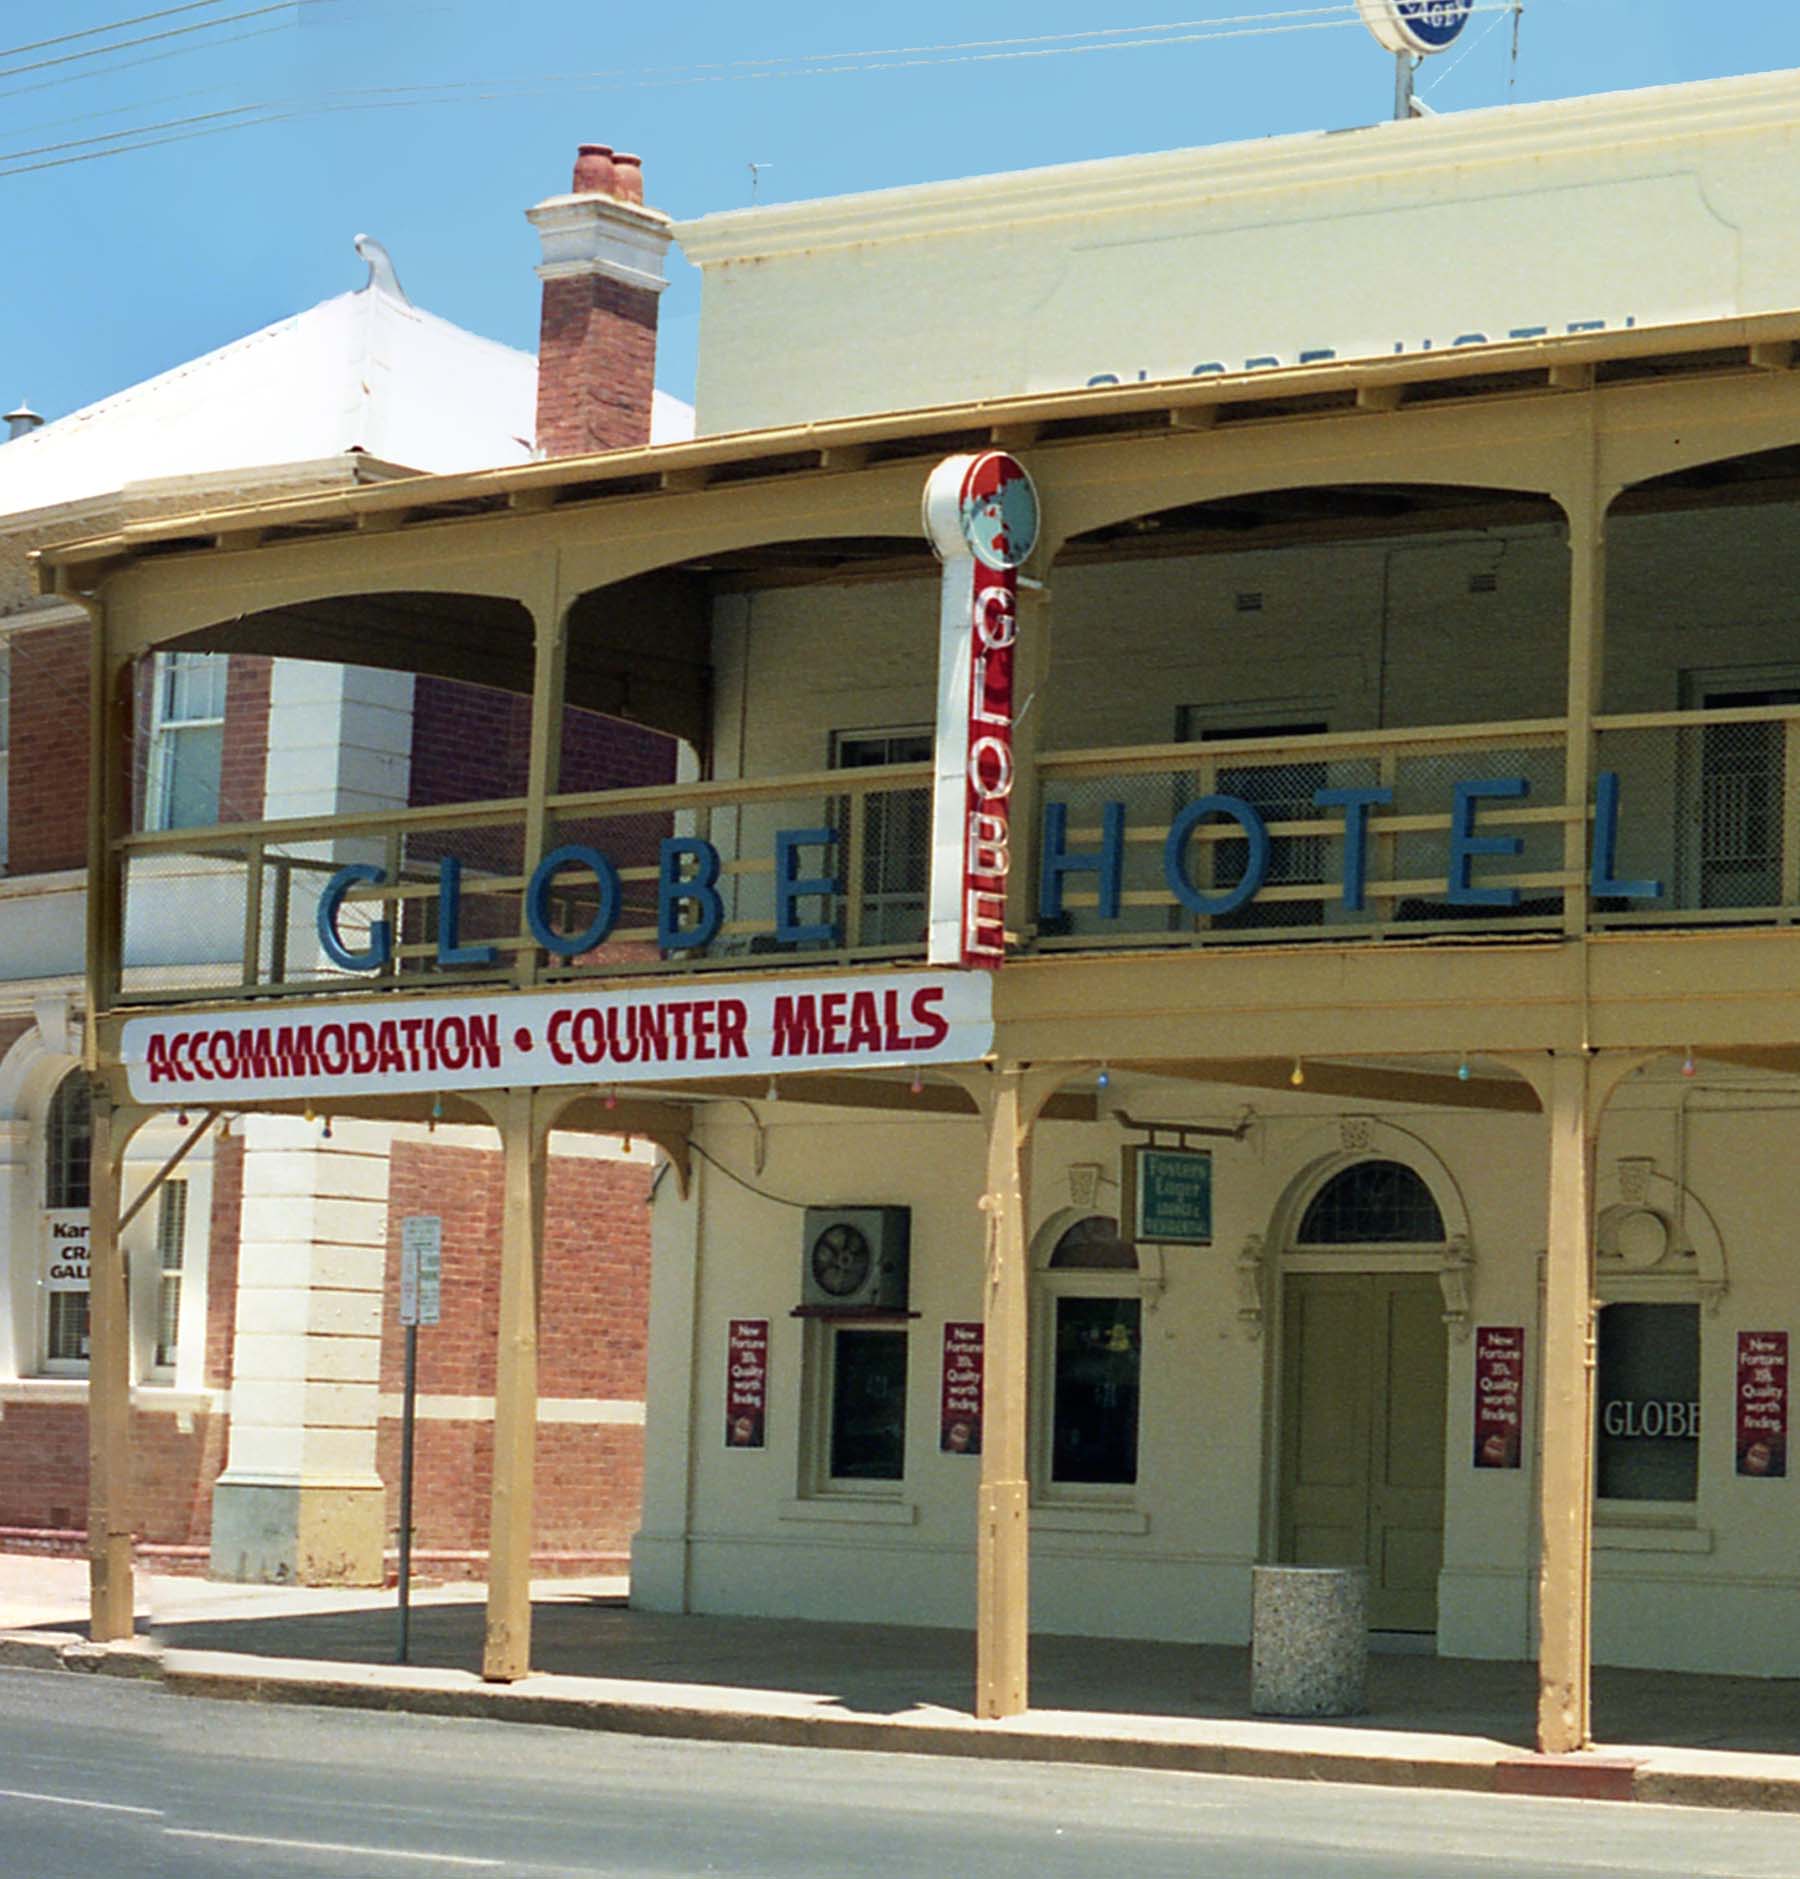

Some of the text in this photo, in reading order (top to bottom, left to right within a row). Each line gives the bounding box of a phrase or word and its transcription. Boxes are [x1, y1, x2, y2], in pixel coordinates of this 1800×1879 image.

[966, 586, 1017, 954] GLOBE
[317, 771, 1664, 970] GLOBE HOTEL
[147, 987, 949, 1082] ACCOMMODATION COUNTER MEALS
[61, 1246, 92, 1260] CR
[1604, 1400, 1700, 1437] GLOBE
